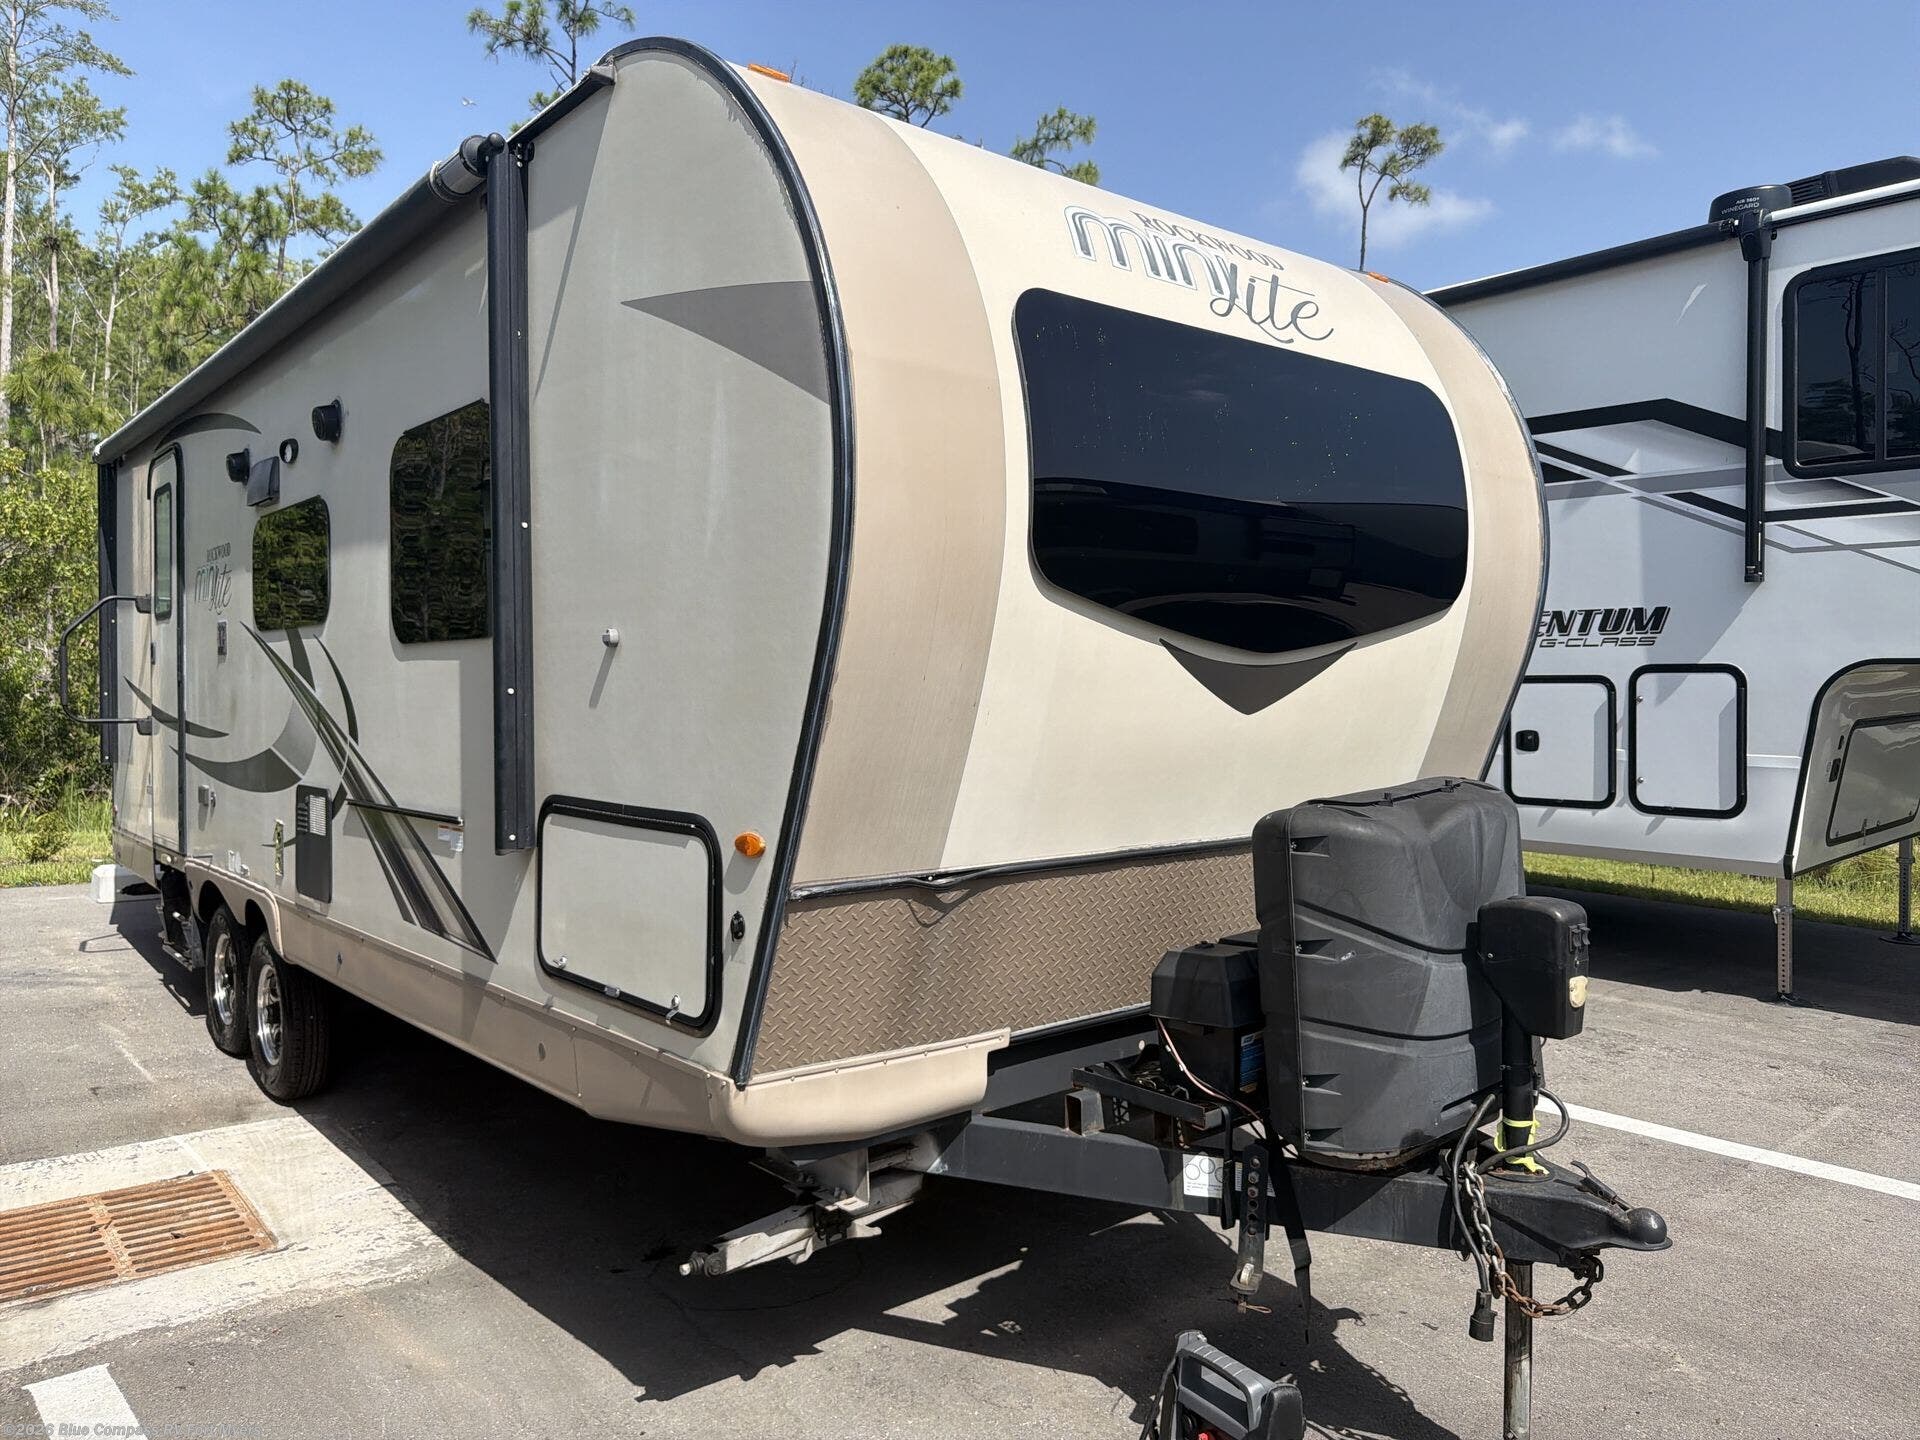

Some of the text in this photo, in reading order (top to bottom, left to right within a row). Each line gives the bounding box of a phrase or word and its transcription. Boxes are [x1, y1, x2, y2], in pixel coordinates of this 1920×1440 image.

[1721, 202, 1760, 215] WINEGARD
[1129, 210, 1284, 270] ROCKWOOD
[1539, 636, 1658, 648] G-CLASS
